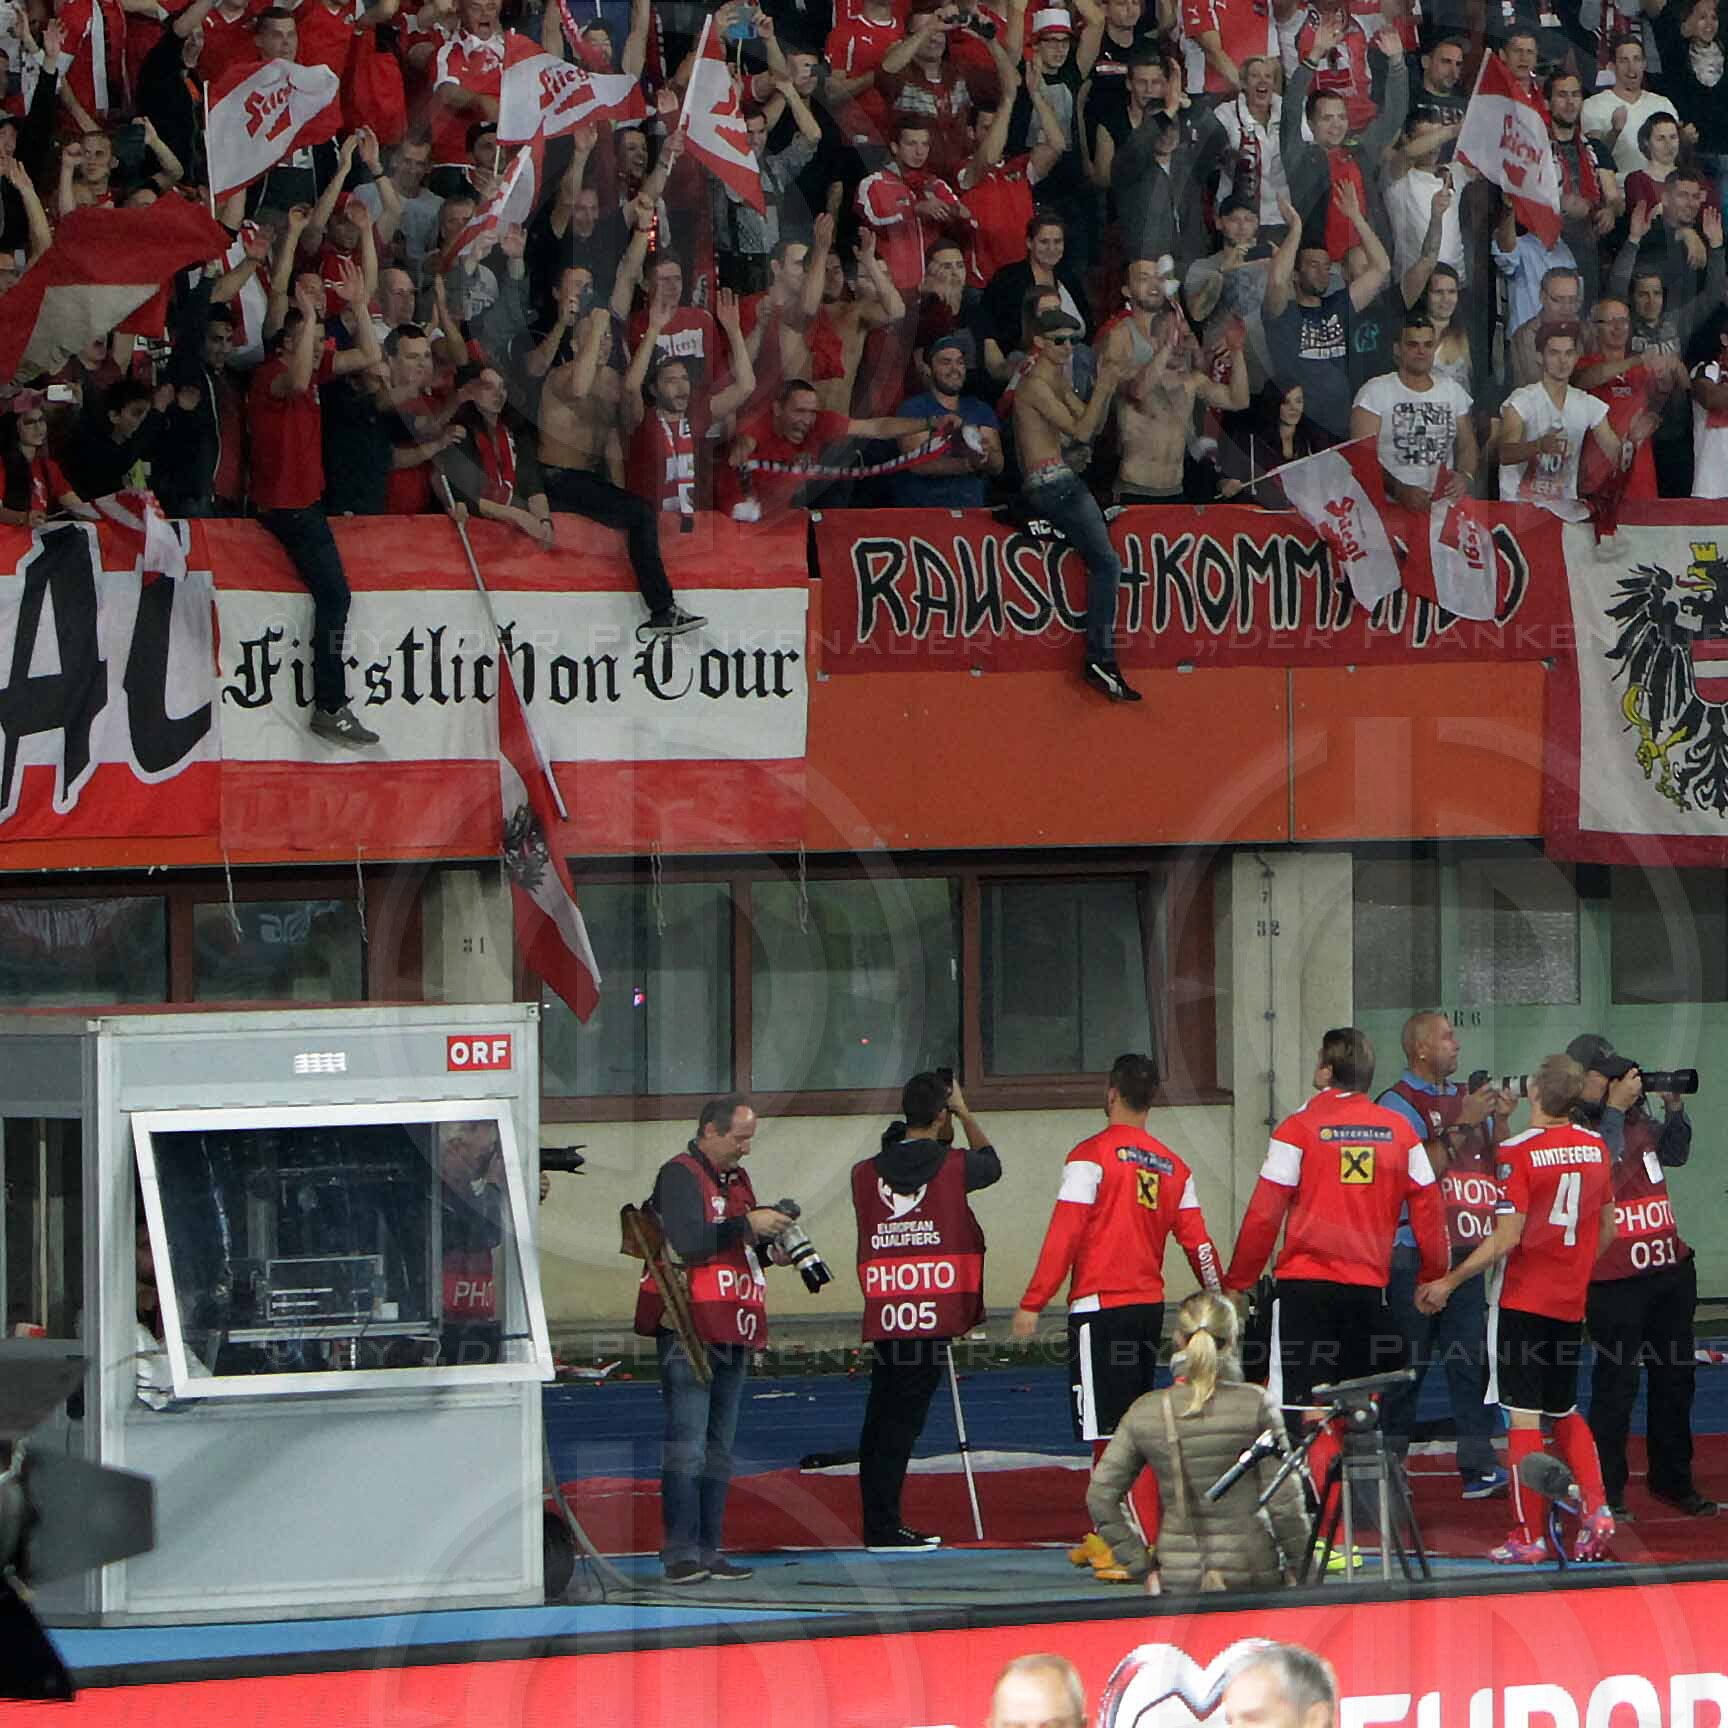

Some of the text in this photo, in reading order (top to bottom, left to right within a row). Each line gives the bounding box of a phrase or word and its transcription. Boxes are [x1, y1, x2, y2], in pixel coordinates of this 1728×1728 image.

[549, 655, 620, 705] on
[631, 635, 802, 702] Tour
[450, 1040, 508, 1065] ORF
[1547, 1170, 1584, 1248] 4
[870, 1231, 942, 1250] QUALIFIERS
[865, 1261, 957, 1295] PHOTO
[880, 1302, 938, 1333] 005
